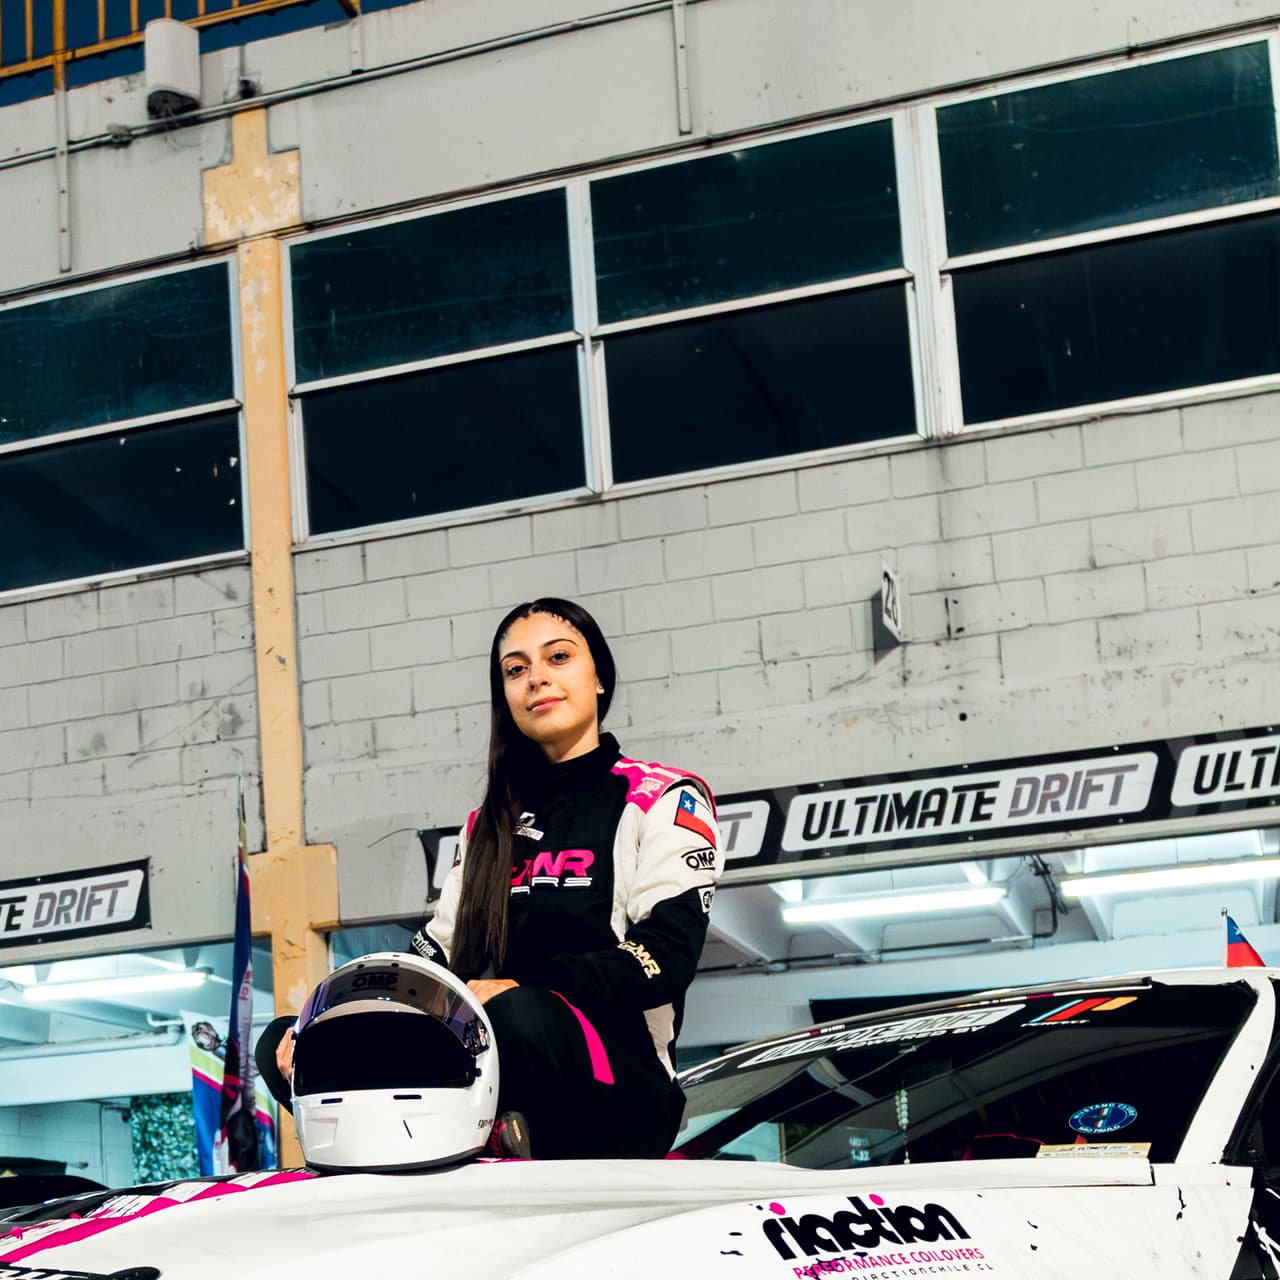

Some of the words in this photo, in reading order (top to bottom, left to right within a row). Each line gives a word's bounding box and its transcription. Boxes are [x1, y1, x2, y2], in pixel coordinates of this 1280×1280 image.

[803, 781, 999, 841] ULTIMATE
[1007, 765, 1138, 818] DRIFT
[33, 880, 129, 928] DRIFT
[351, 974, 399, 988] OMP
[837, 1030, 947, 1051] POWERED
[762, 1193, 972, 1261] riaction
[792, 1252, 909, 1280] PERFORMANCE
[910, 1248, 985, 1264] COILOVERS
